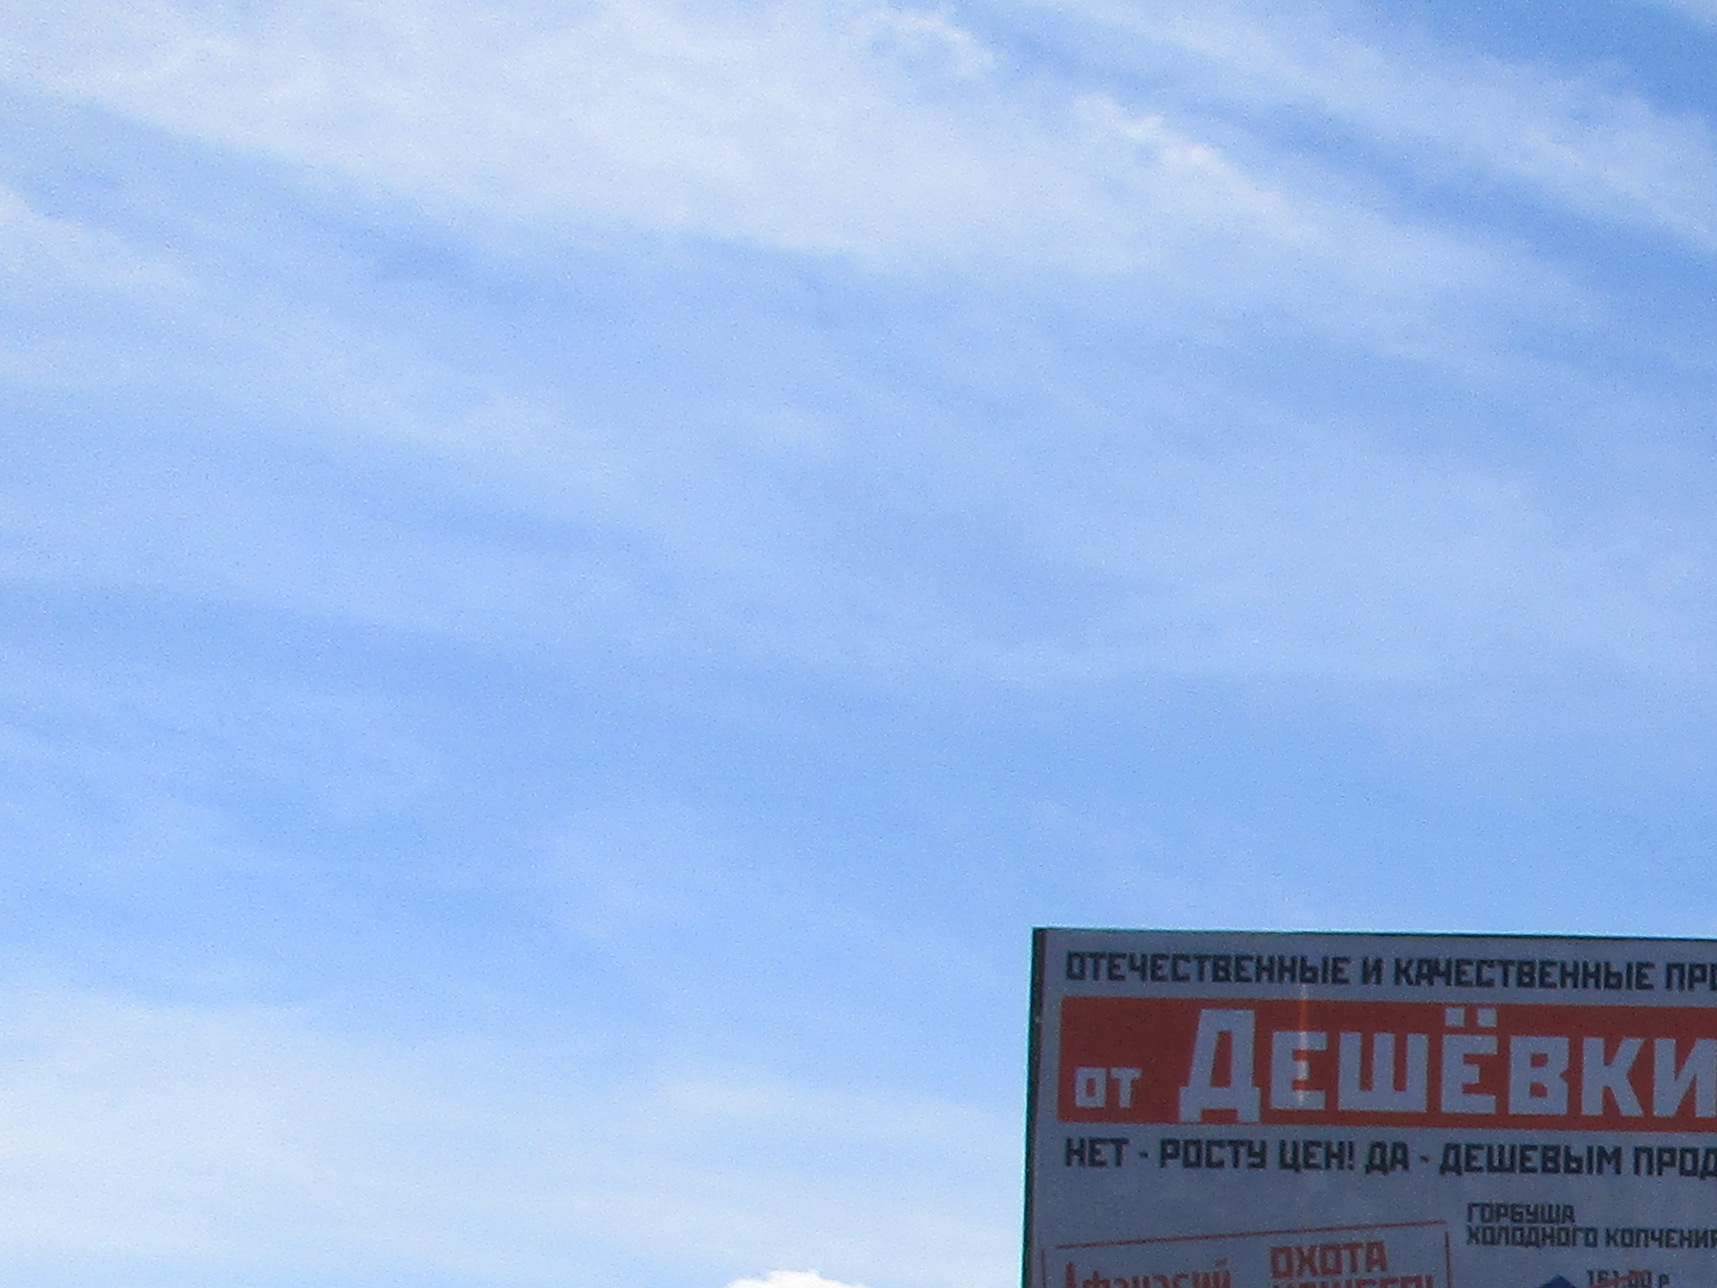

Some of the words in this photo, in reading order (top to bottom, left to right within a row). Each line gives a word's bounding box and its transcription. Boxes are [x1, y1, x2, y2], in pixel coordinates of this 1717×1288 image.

[1065, 950, 1351, 985] ОТЕЧЕСТВЕННЫЕ
[1362, 956, 1384, 985] И
[1394, 956, 1656, 991] КАЧЕСТВЕННЫЕ
[1064, 1137, 1130, 1168] НЕТ
[1159, 1138, 1268, 1170] РОСТУ
[1278, 1139, 1355, 1173] ЦЕН!
[1365, 1141, 1410, 1175] ДА
[1439, 1142, 1623, 1176] ДЕШЕВЫМ
[1467, 1202, 1576, 1224] ГОРБУША
[1466, 1225, 1598, 1249] ХОЛОДНОГО
[1270, 1240, 1388, 1279] ОХОТА
